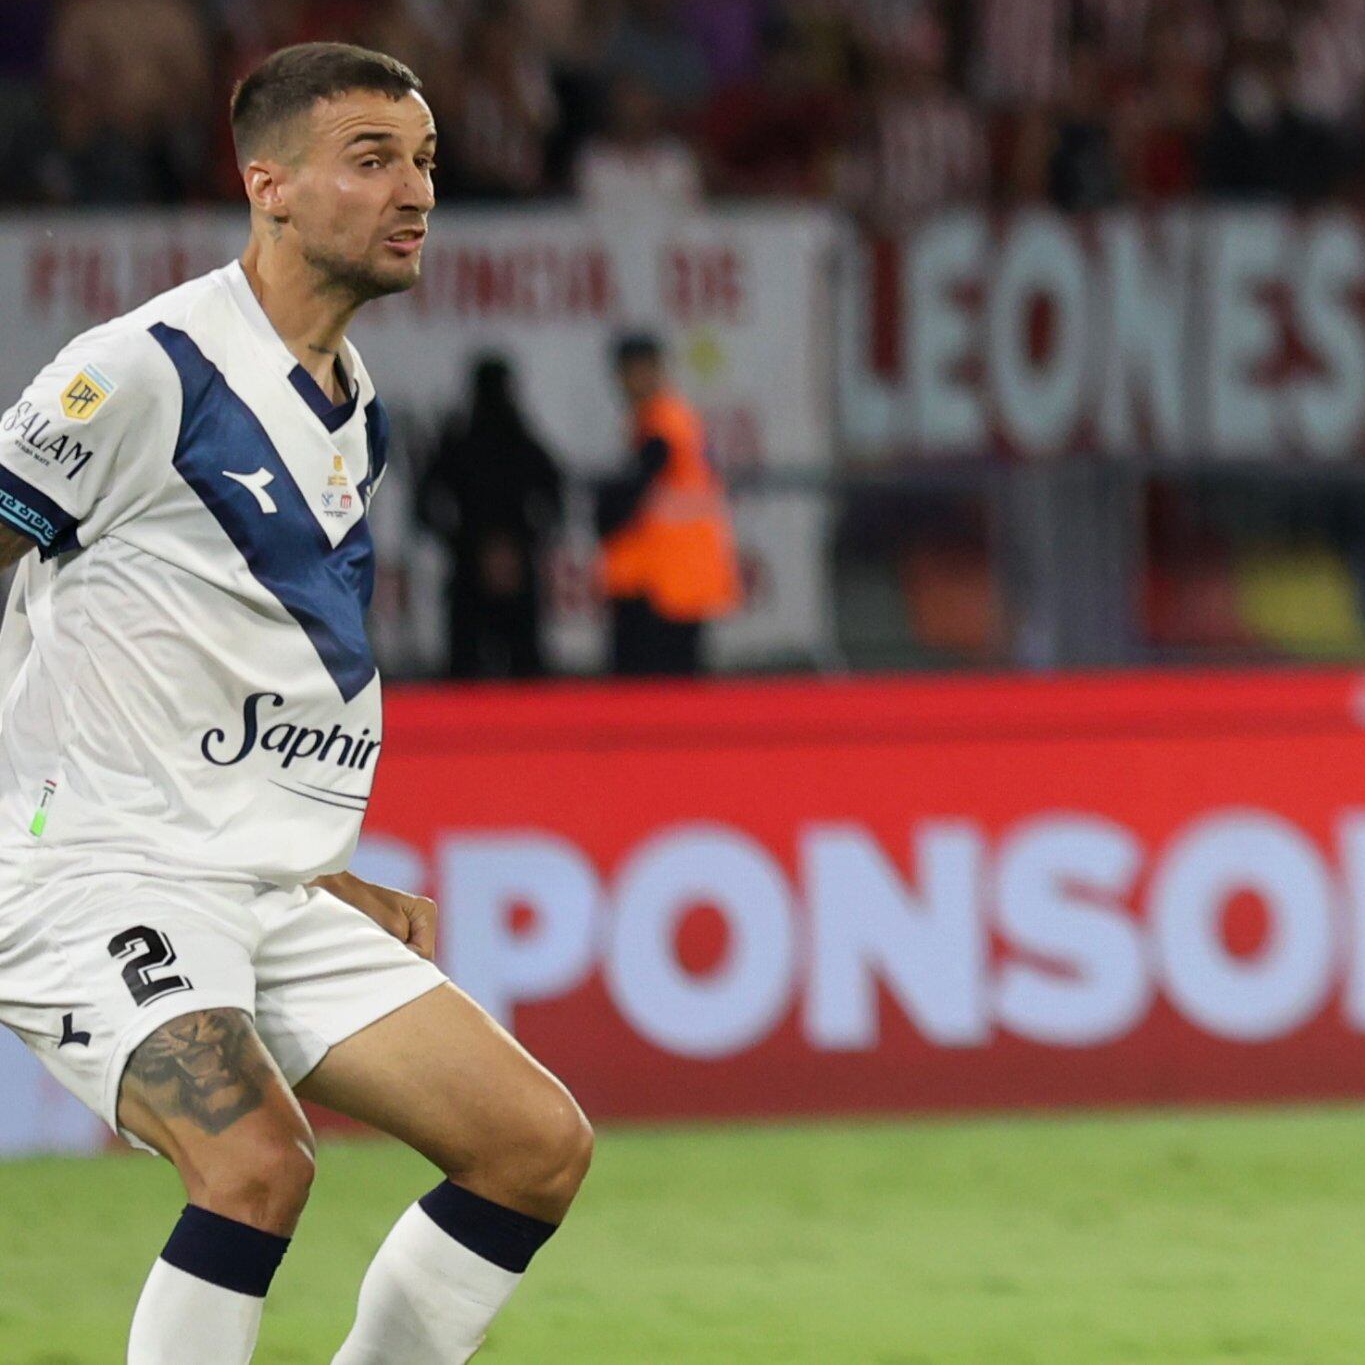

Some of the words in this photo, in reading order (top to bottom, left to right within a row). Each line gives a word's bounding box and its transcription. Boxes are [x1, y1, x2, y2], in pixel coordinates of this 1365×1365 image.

[3, 400, 94, 481] SALAM
[201, 692, 382, 770] Saphir
[106, 925, 194, 1008] 2
